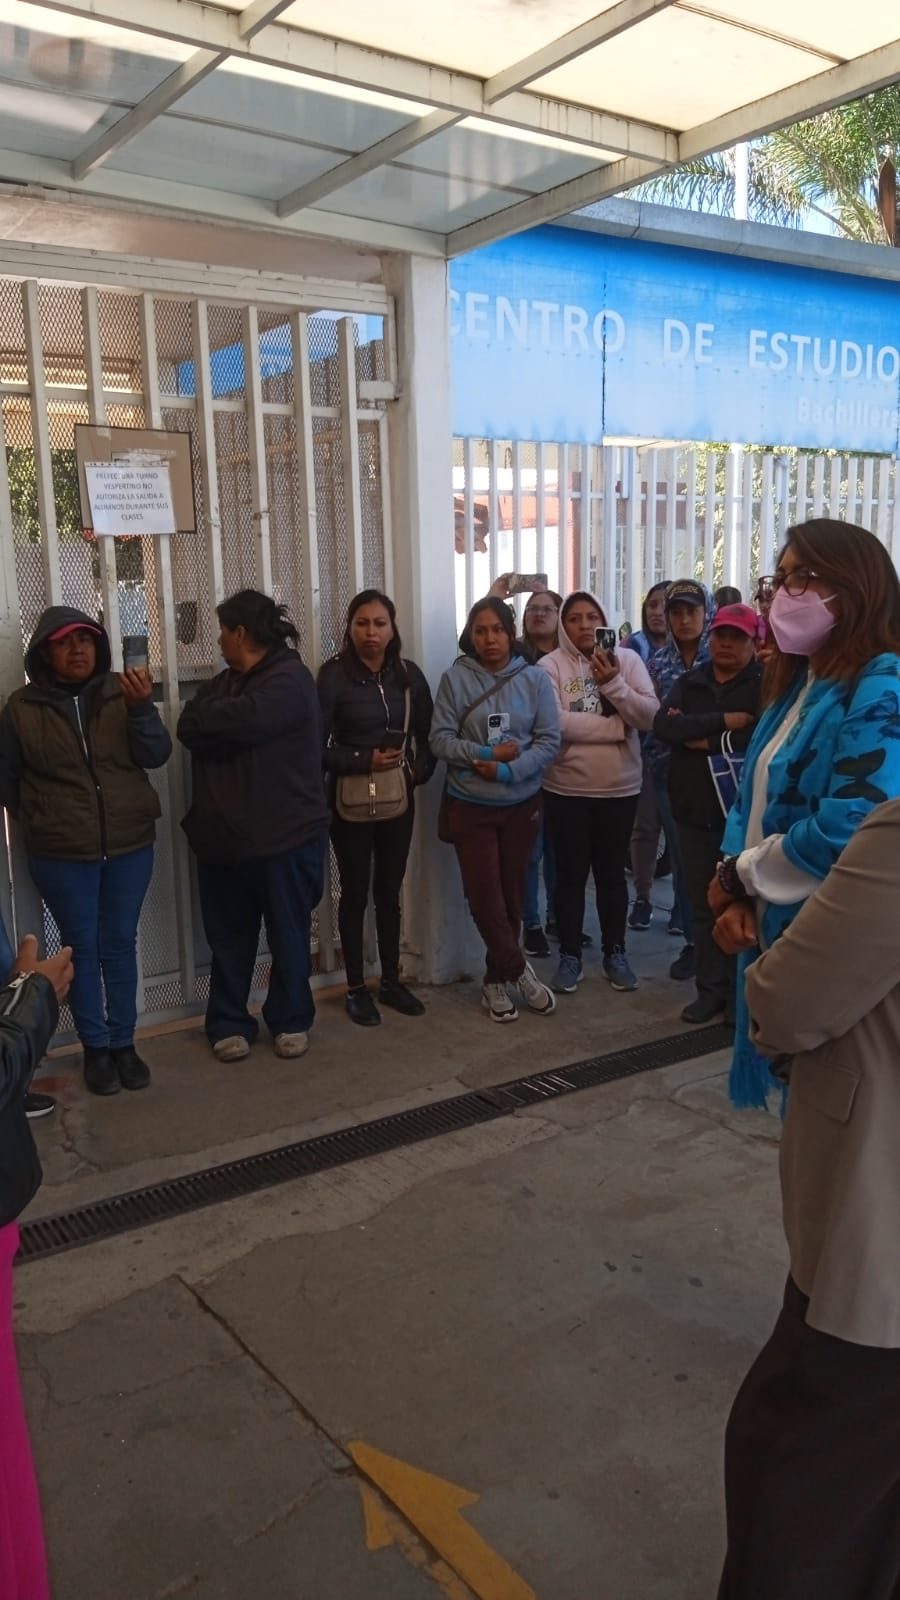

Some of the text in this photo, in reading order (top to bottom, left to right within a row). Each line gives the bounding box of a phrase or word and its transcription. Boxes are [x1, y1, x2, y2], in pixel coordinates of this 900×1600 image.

[663, 319, 715, 364] DE
[749, 329, 899, 382] ESTUDIO
[96, 472, 159, 480] PREFECURA TURNO
